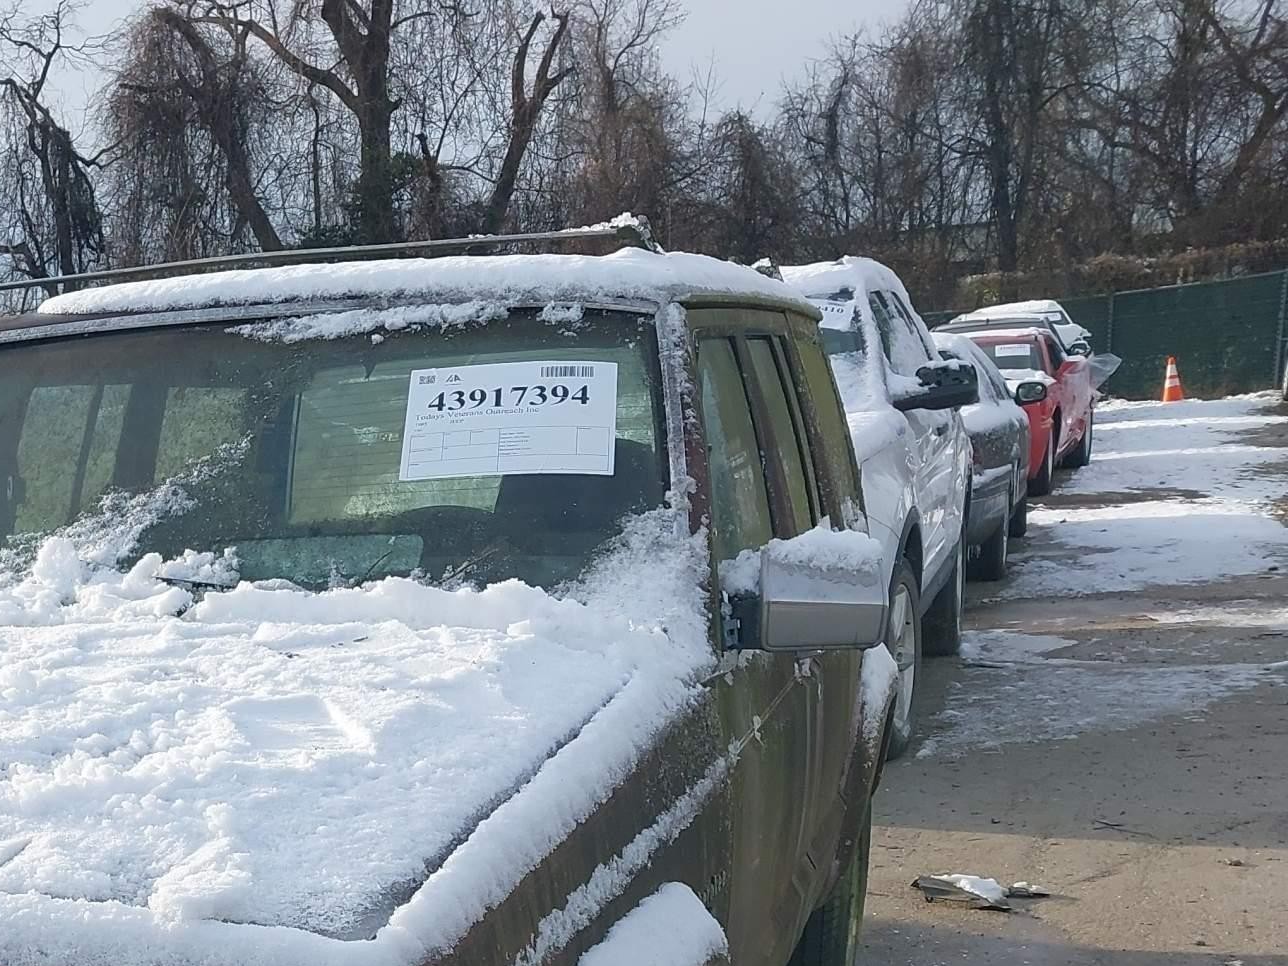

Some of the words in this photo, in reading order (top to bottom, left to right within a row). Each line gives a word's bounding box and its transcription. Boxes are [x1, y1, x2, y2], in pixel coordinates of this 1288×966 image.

[428, 384, 590, 412] 43917394
[416, 413, 445, 421] Todays
[447, 410, 484, 418] Veterans
[485, 407, 524, 415] Outreach
